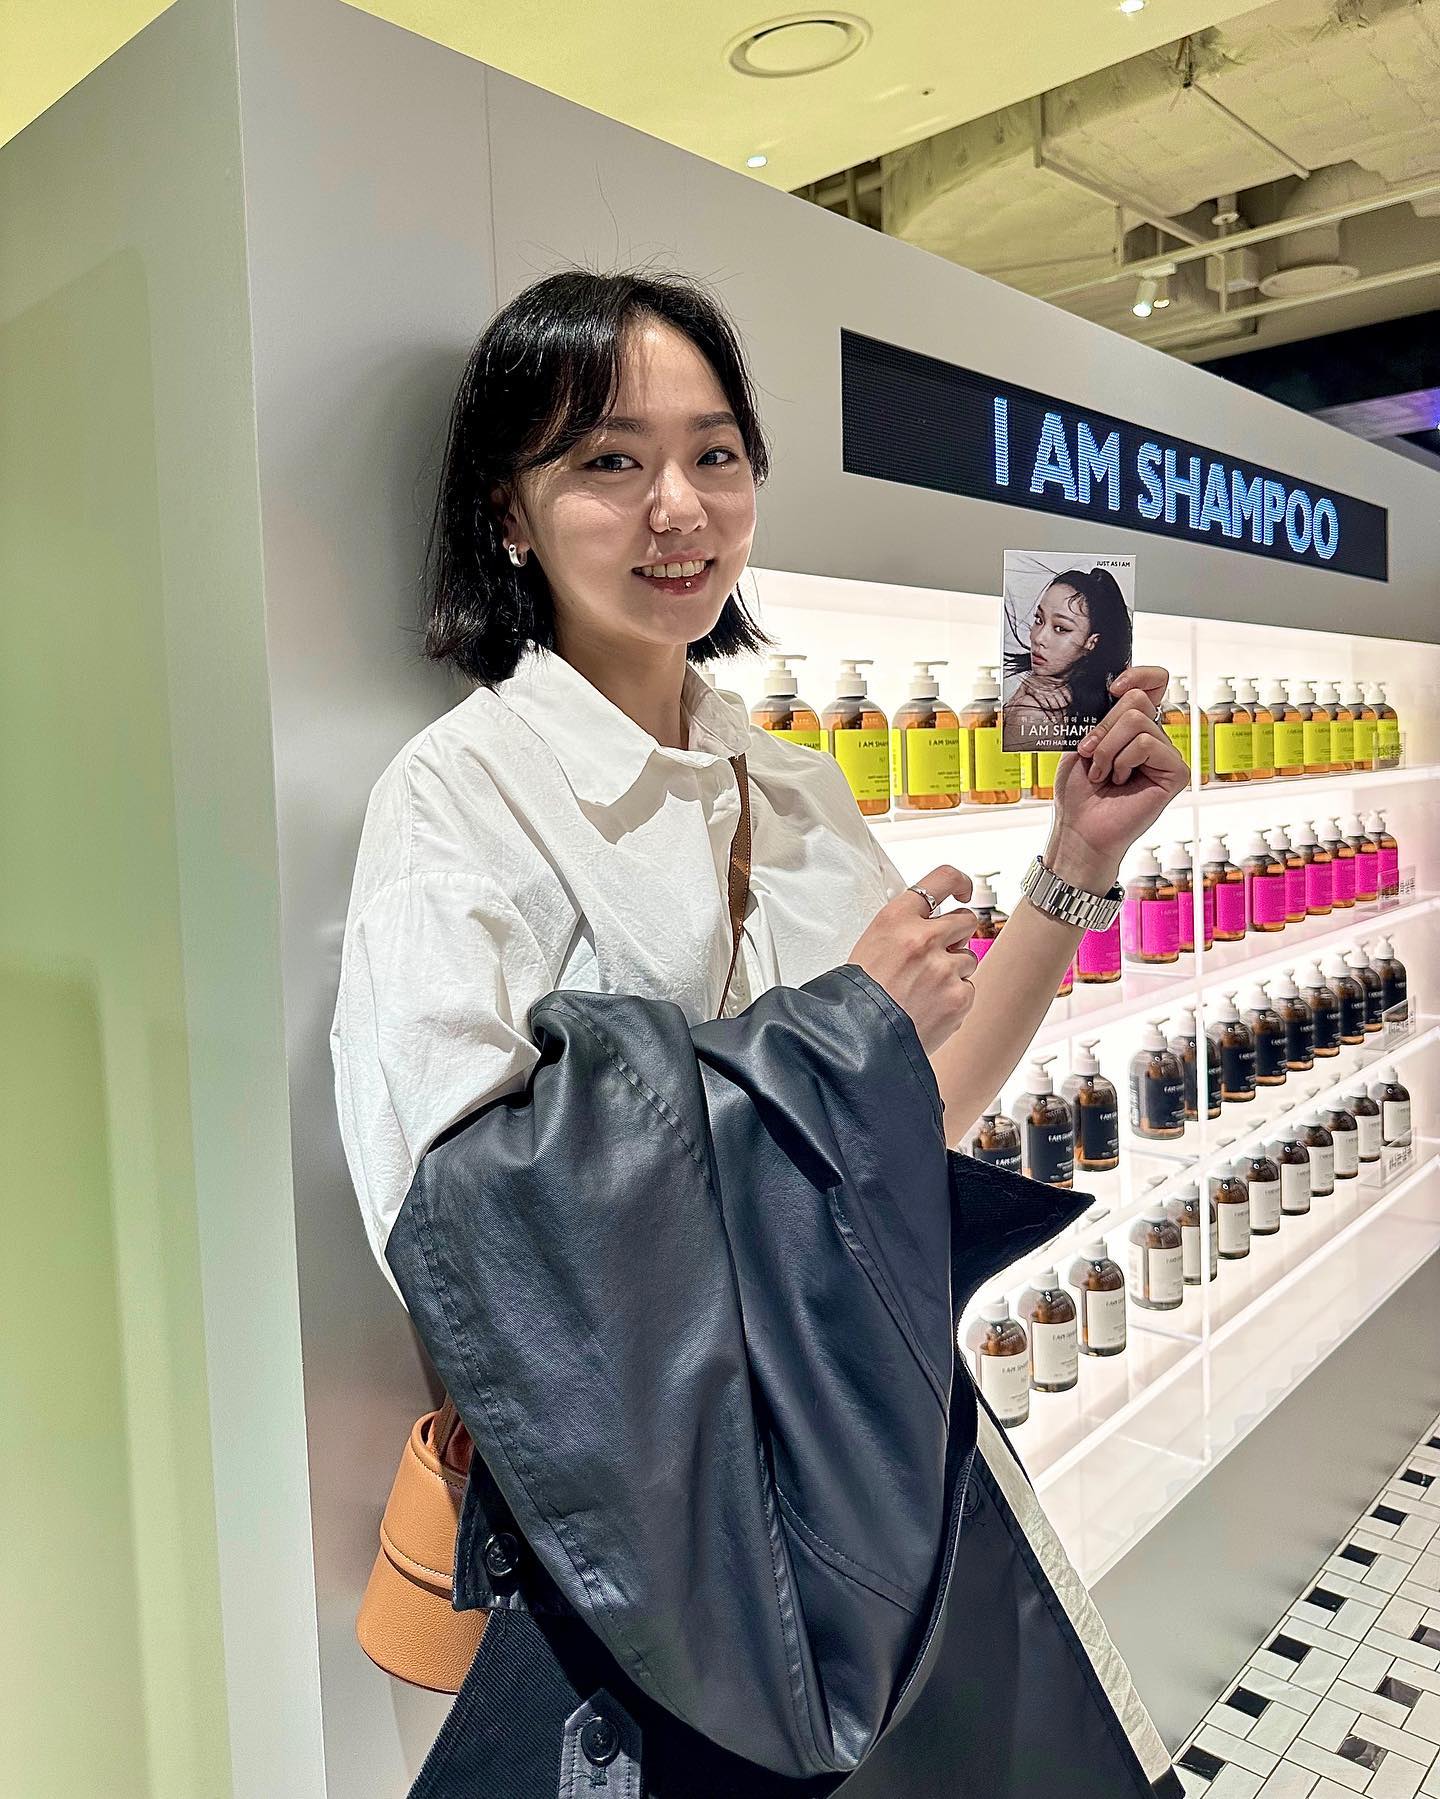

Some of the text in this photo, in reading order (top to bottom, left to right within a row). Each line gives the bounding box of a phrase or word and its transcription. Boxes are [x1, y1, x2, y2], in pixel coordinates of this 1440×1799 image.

[994, 396, 1339, 560] I AM SHAMPOO
[1020, 724, 1096, 736] I AM SHAMP
